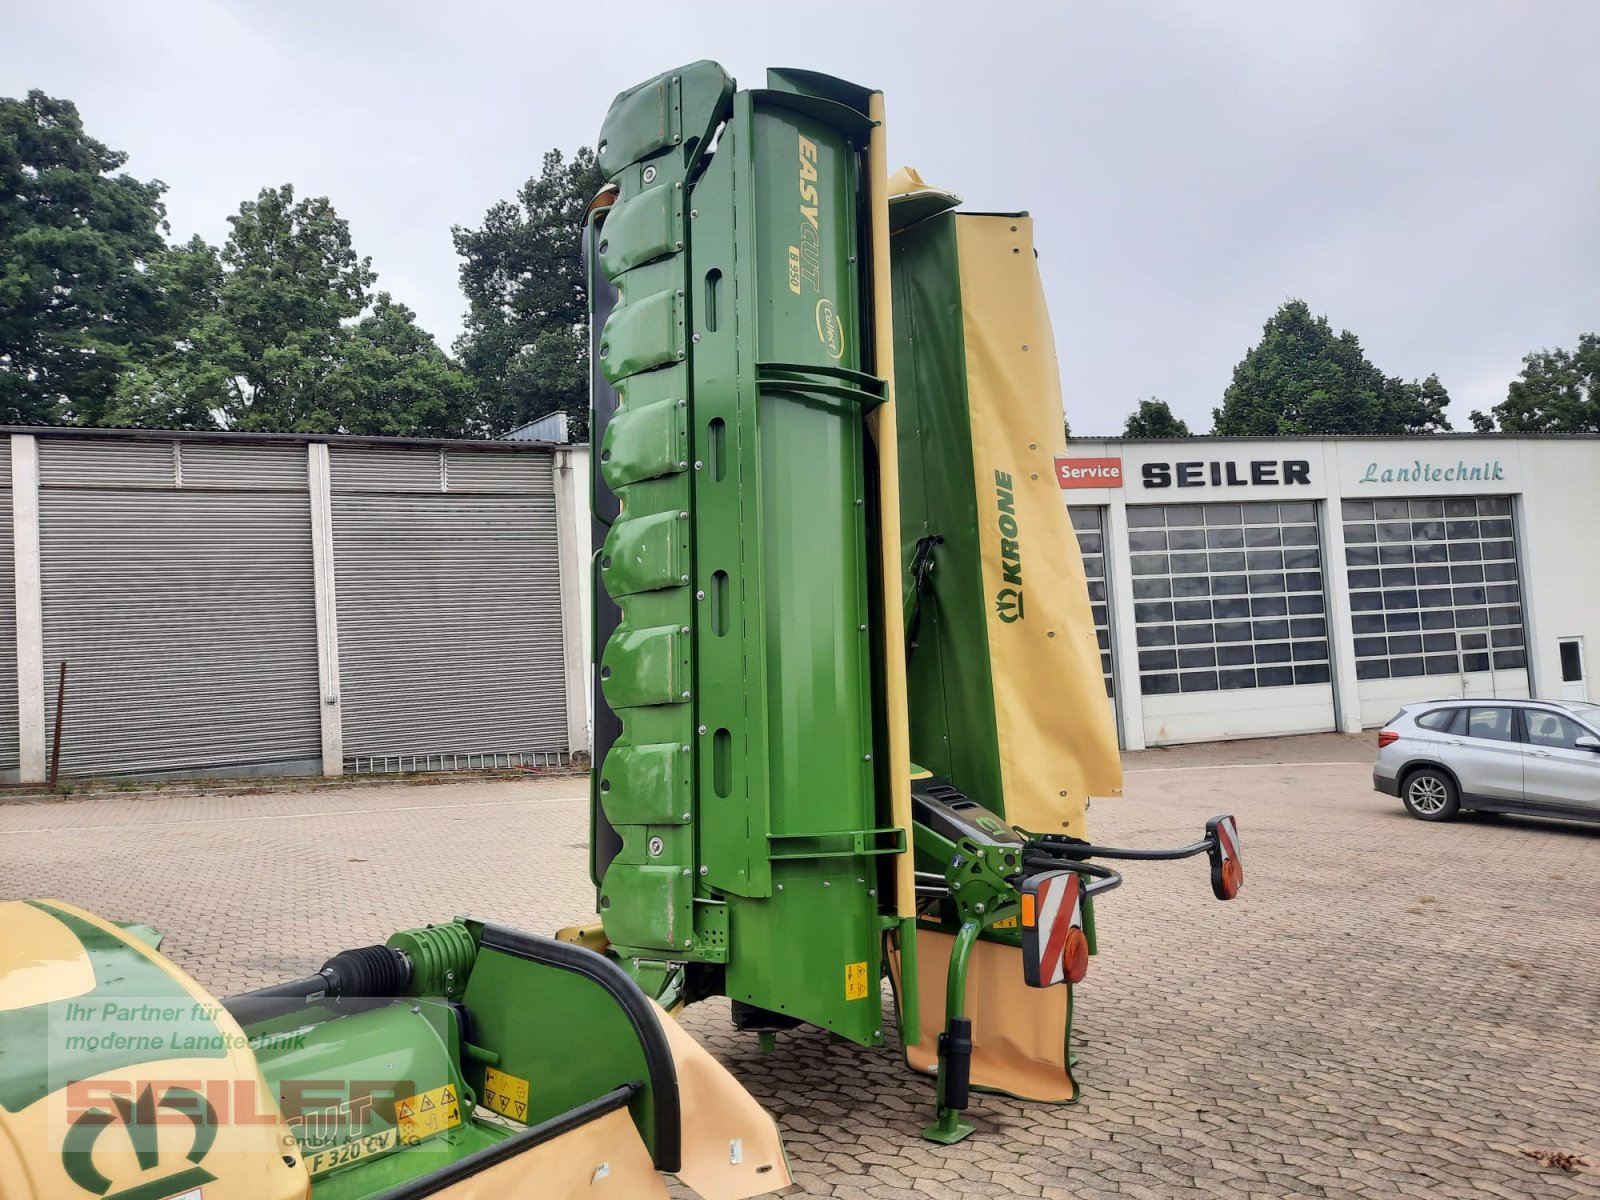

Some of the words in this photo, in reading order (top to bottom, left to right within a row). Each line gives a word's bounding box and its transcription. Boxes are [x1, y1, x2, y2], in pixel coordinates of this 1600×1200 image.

[798, 134, 820, 293] EASYCUT
[790, 252, 799, 262] B
[790, 265, 799, 287] 950
[823, 306, 837, 350] Collect
[1060, 464, 1120, 481] Service
[1141, 459, 1312, 489] SEILER
[1359, 460, 1506, 484] Landtechnik
[994, 469, 1023, 586] KRONE
[312, 1154, 324, 1173] F
[328, 1142, 360, 1168] 320
